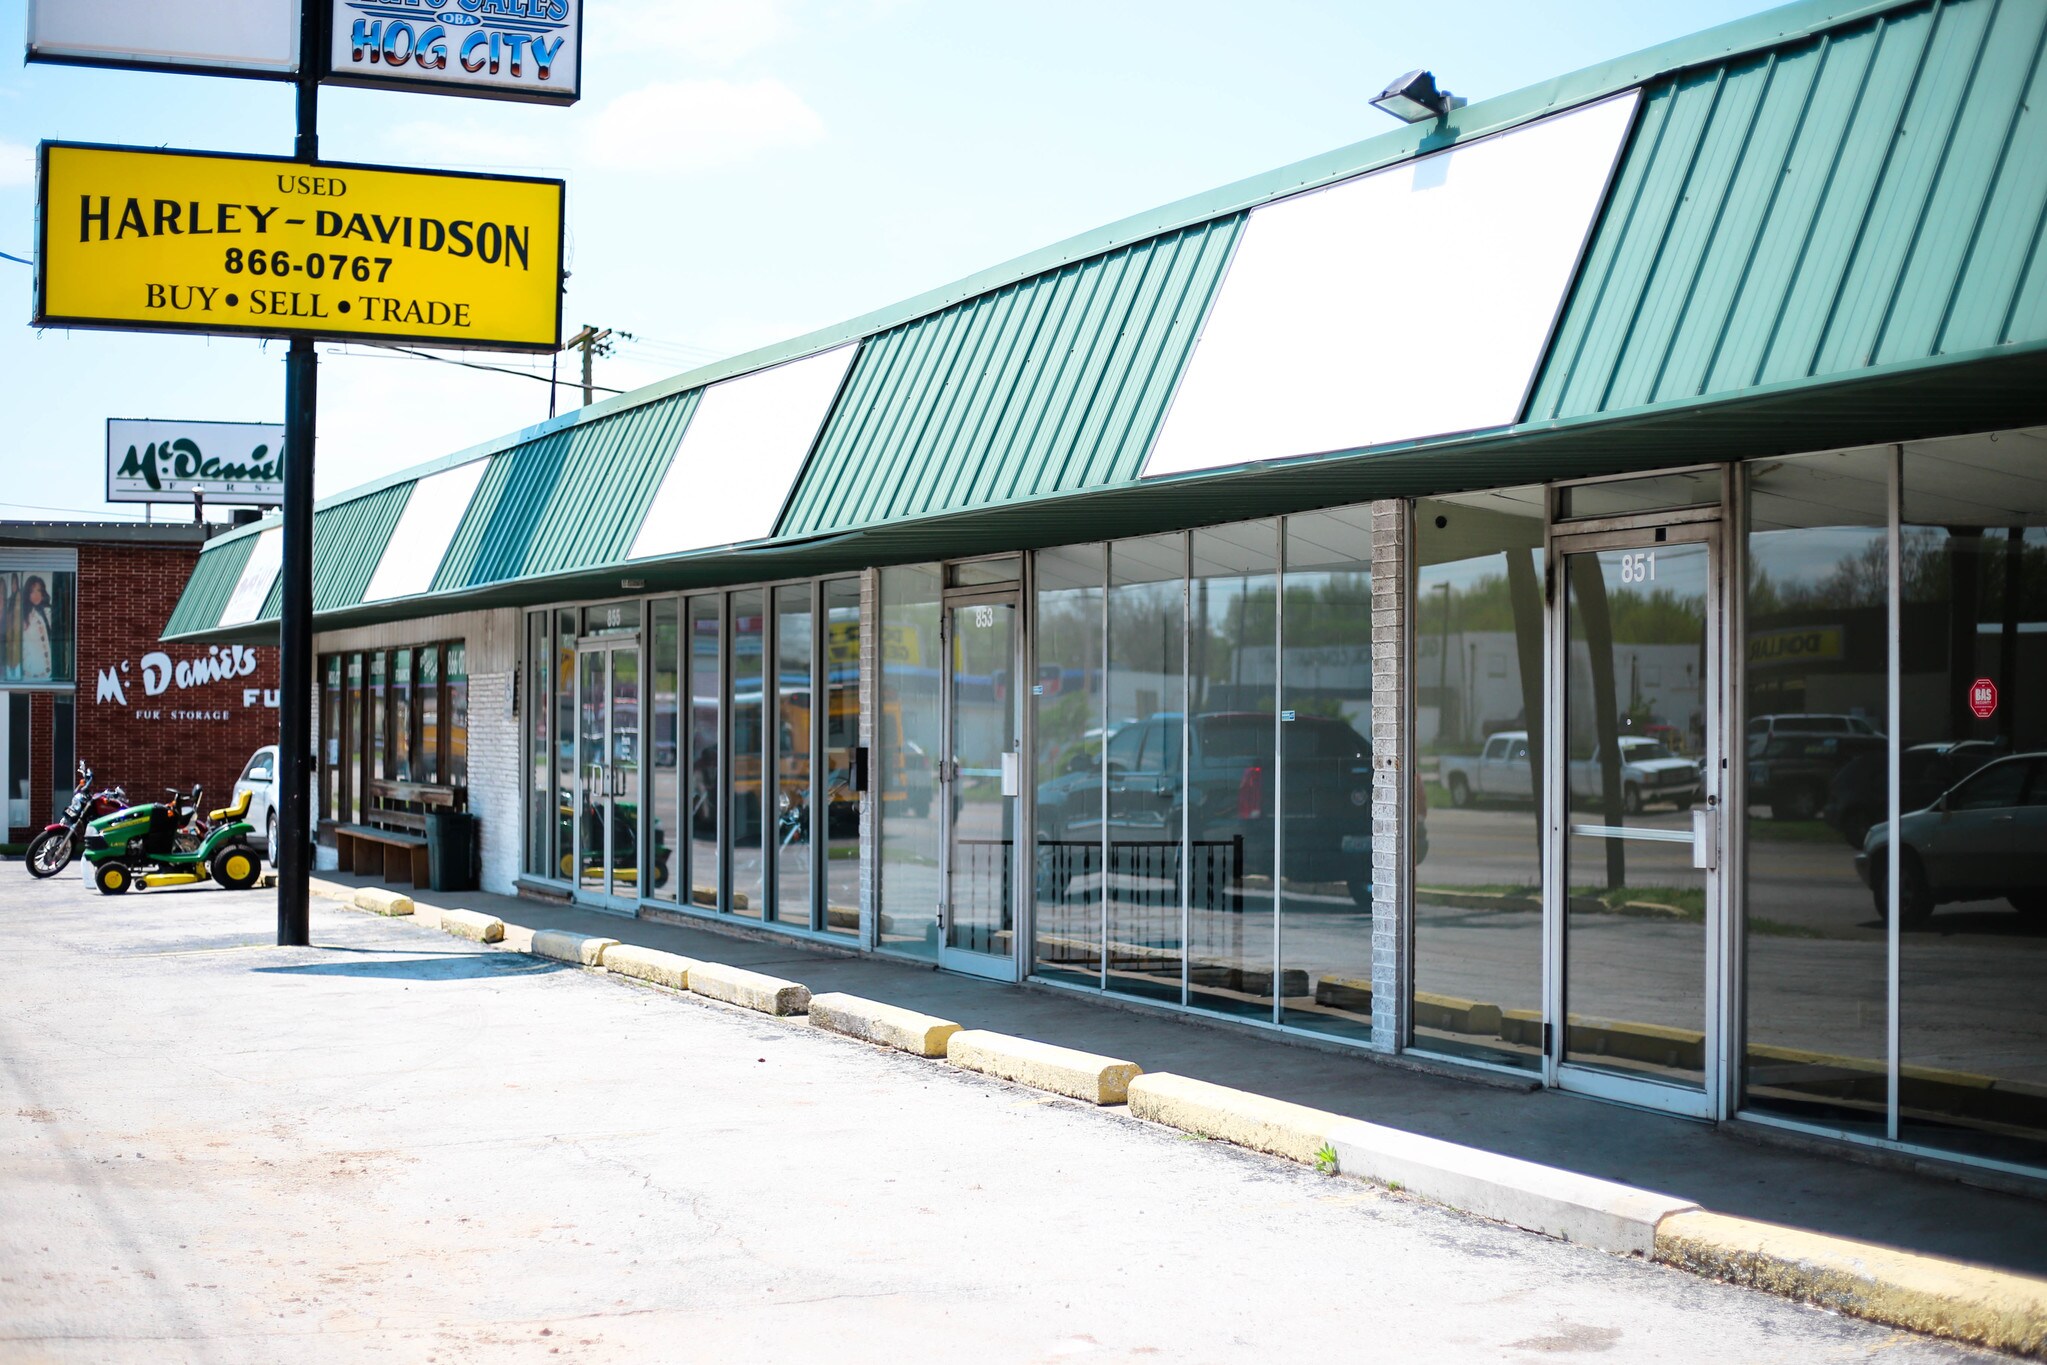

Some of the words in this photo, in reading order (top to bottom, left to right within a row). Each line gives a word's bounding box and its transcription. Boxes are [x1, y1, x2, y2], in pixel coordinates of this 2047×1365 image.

[351, 18, 448, 70] HOG
[460, 30, 565, 80] CITY
[277, 175, 347, 197] USED
[224, 247, 393, 284] 866-0767
[145, 283, 220, 312] BUY
[249, 289, 329, 318] SELL
[358, 296, 472, 328] TRADE
[1621, 551, 1655, 584] 851
[975, 607, 993, 628] 853
[1975, 688, 1992, 701] BAS
[135, 710, 161, 720] FUR
[170, 710, 231, 720] STORAGE
